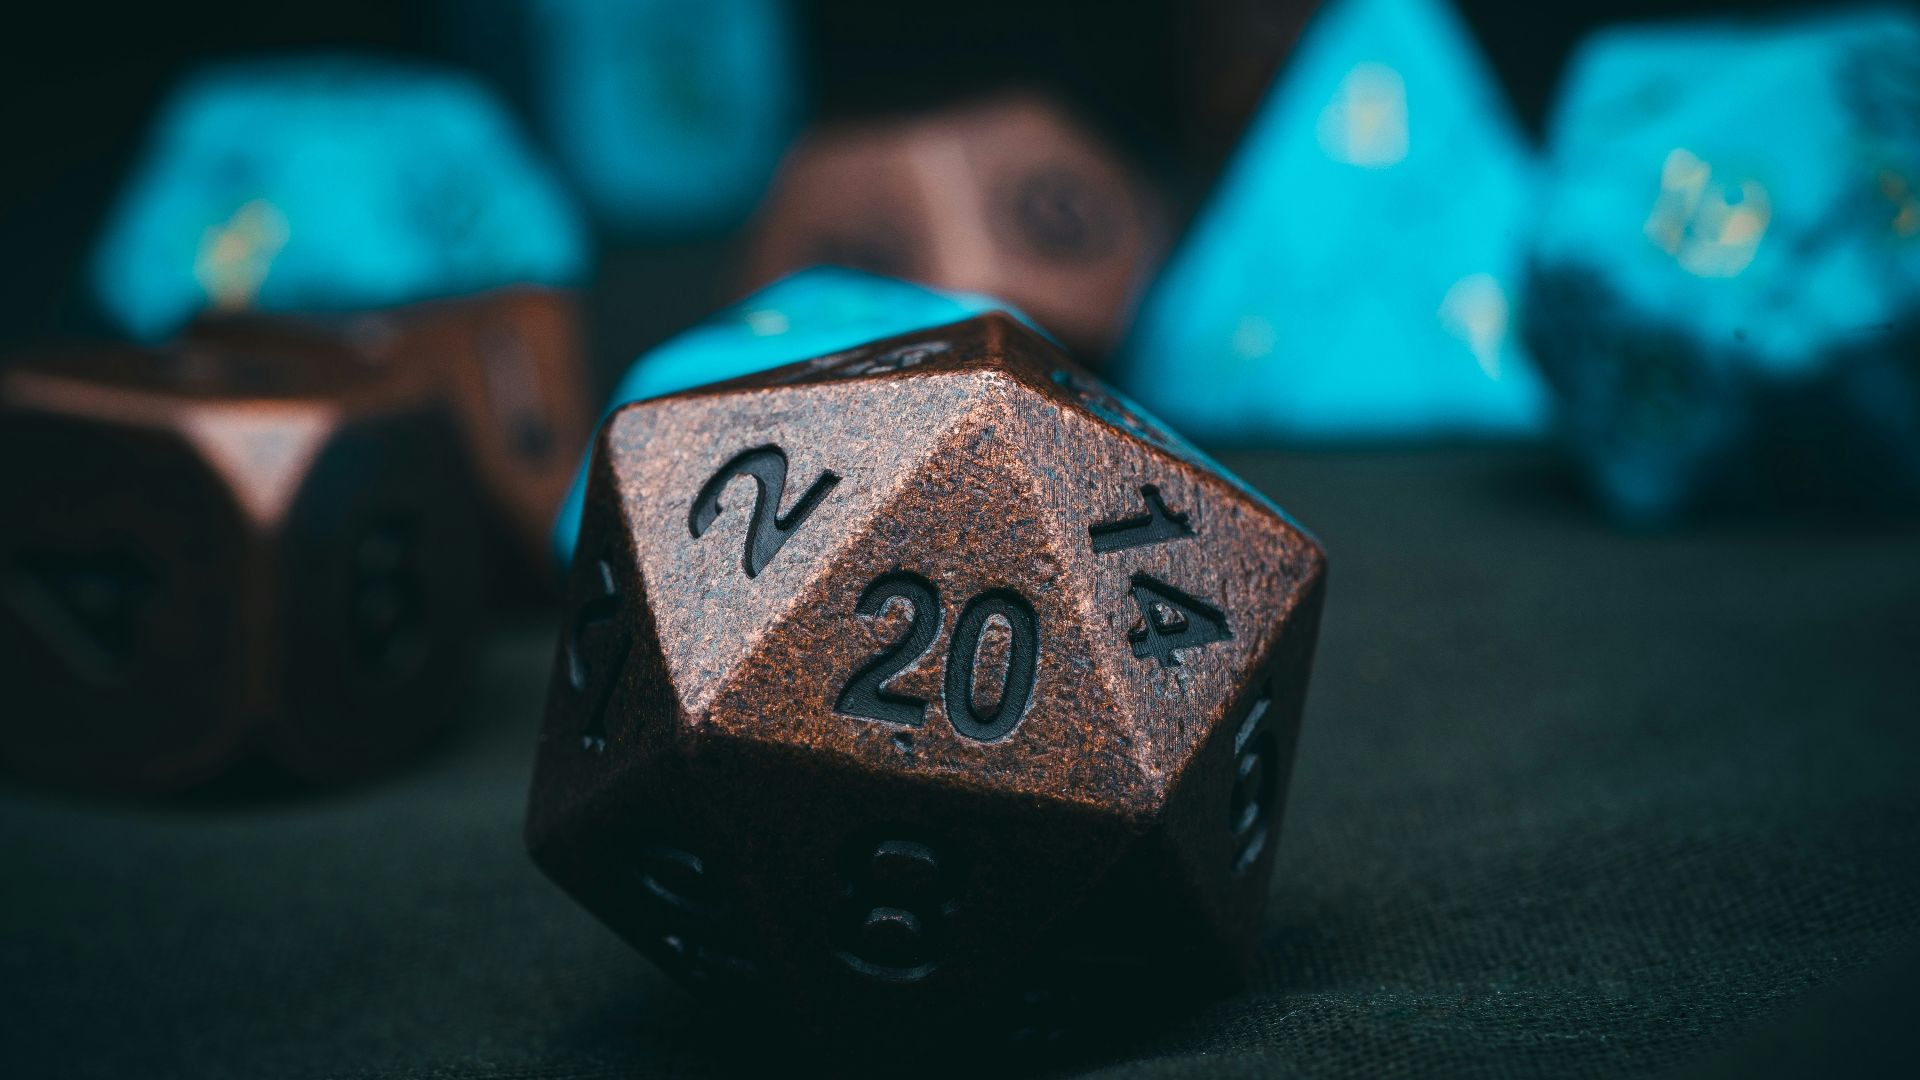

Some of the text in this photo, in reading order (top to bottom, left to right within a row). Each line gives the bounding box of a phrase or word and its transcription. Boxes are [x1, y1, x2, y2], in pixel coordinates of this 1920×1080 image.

[688, 443, 843, 578] 2
[1089, 484, 1235, 667] 14
[833, 568, 1042, 745] 20
